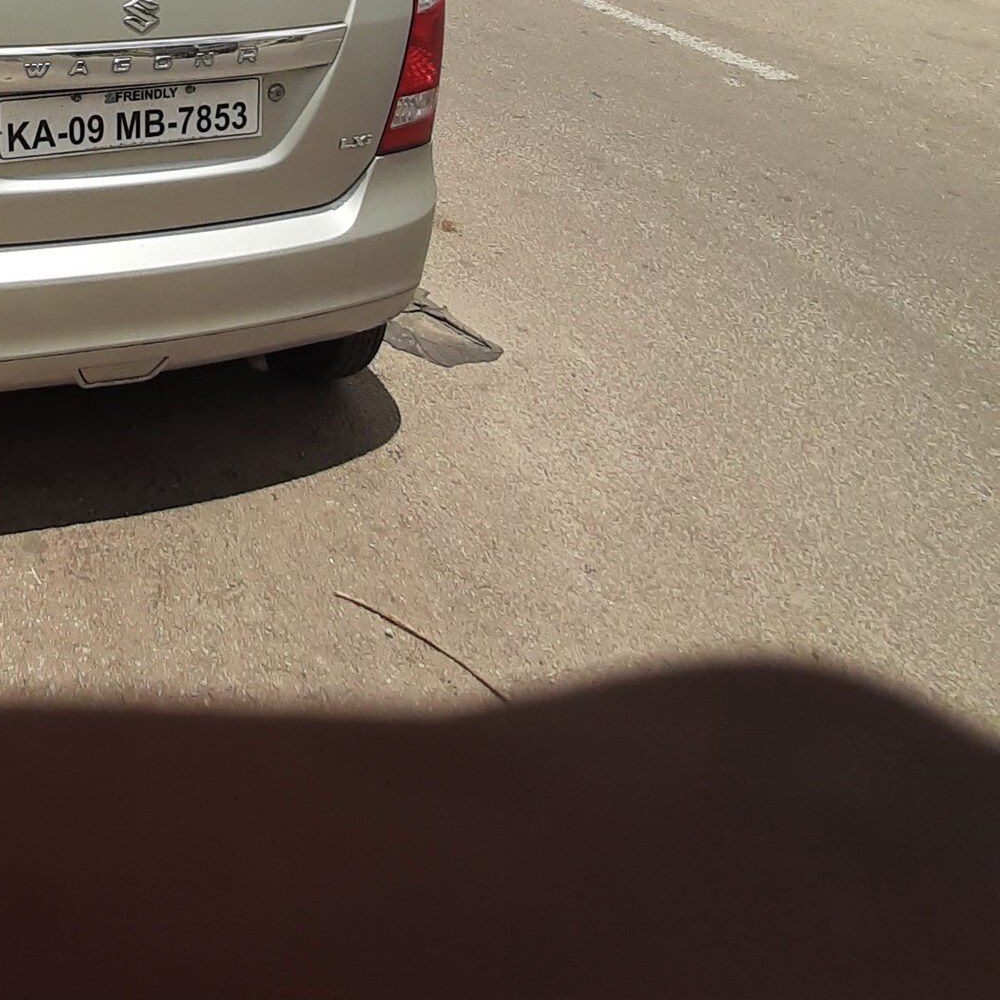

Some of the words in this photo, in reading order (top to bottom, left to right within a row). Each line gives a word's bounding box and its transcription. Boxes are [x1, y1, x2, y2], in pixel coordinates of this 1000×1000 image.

[114, 86, 178, 103] FREINDLY
[7, 120, 106, 154] KA-09
[116, 100, 248, 142] MB-7853
